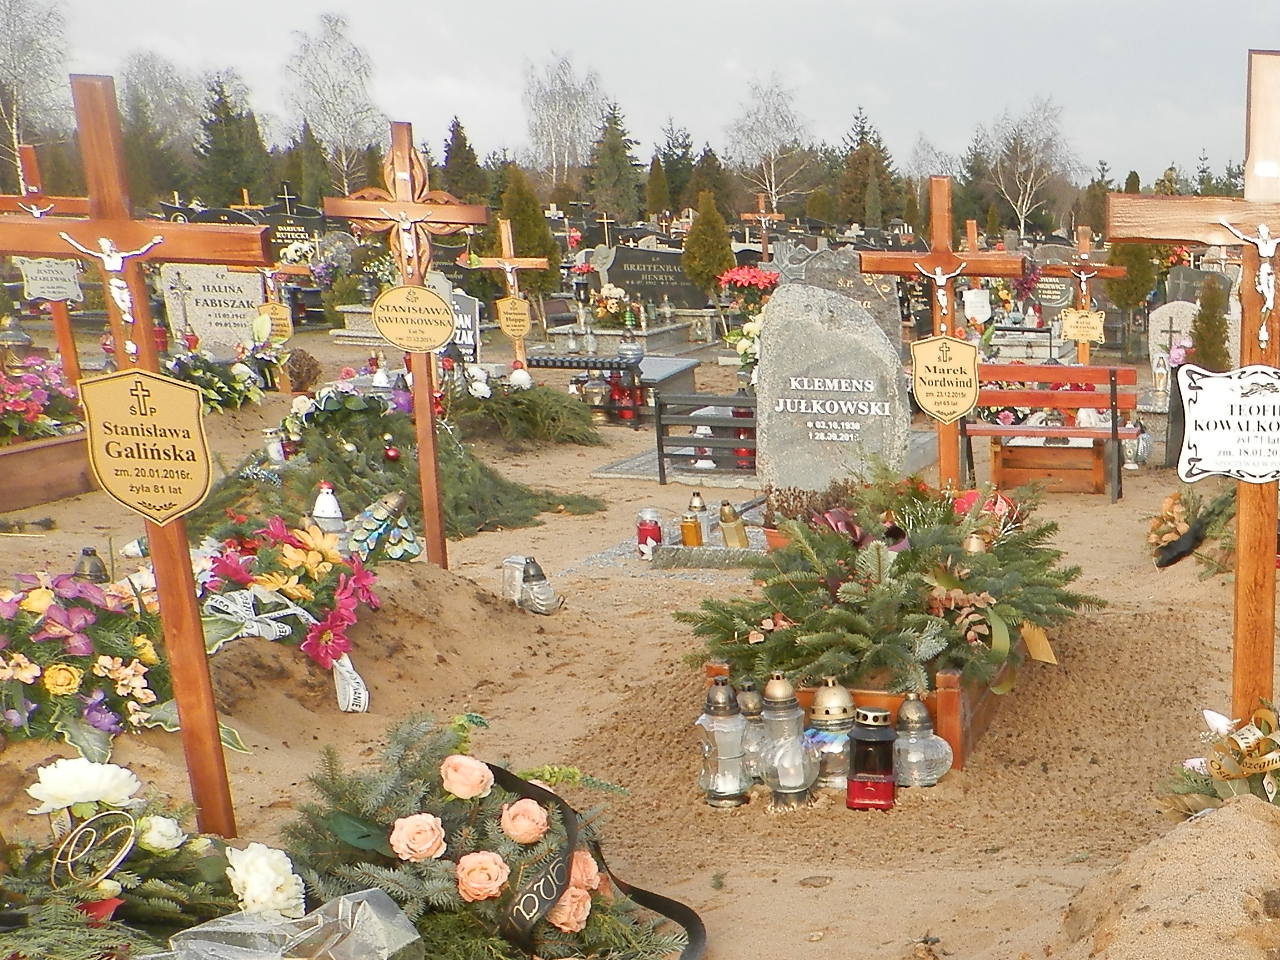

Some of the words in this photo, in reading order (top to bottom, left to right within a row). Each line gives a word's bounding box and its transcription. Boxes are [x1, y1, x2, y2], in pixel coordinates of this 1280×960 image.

[623, 263, 682, 272] BREITENBAC
[203, 285, 243, 294] HALINA
[194, 299, 255, 309] FABISZAK
[379, 305, 450, 316] STANISŁAWA
[378, 316, 452, 328] KWIATKOWSKA
[925, 366, 967, 375] Marek
[789, 377, 874, 392] KLEMENS
[919, 376, 973, 388] Nordwind
[774, 398, 891, 416] JUŁKOWSKI
[103, 421, 191, 439] Stanisława
[105, 441, 197, 462] Galińska
[114, 468, 132, 477] zm.
[135, 468, 193, 480] 20.01.2016r.
[129, 484, 151, 495] żyła
[154, 485, 165, 494] 81
[169, 486, 183, 495] lat
